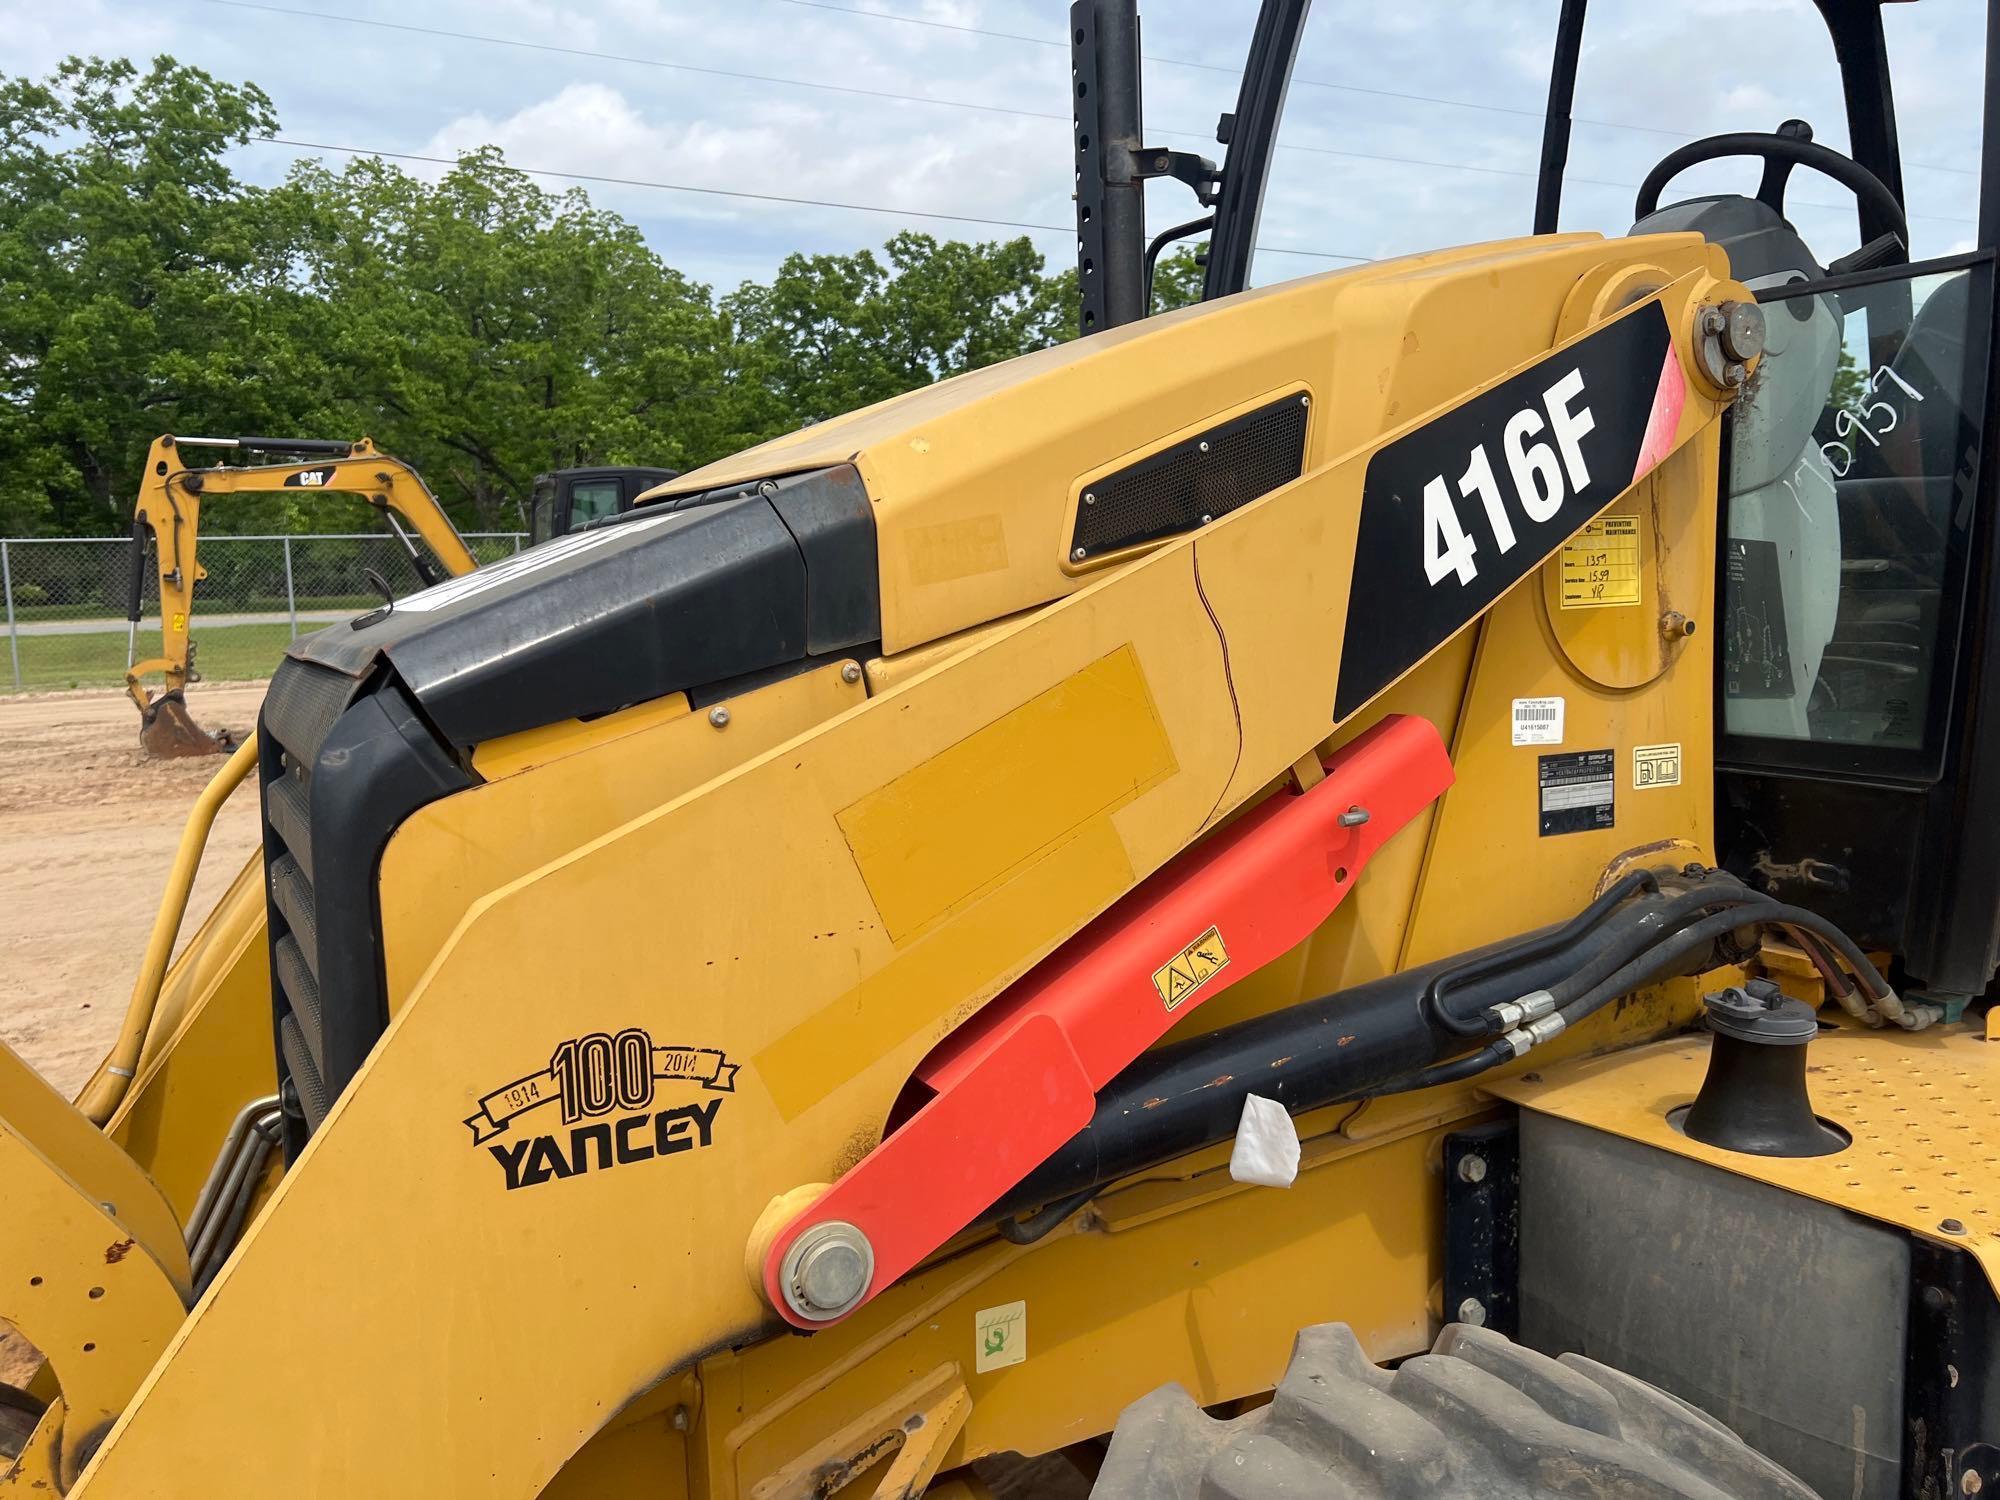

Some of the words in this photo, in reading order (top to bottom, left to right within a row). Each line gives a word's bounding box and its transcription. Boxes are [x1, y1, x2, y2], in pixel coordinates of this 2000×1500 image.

[300, 471, 324, 486] CAT
[1423, 367, 1596, 587] 416F
[504, 1082, 540, 1110] 1914
[550, 1027, 655, 1126] 100
[664, 1053, 698, 1073] 2014
[488, 1098, 723, 1191] YANCEY
